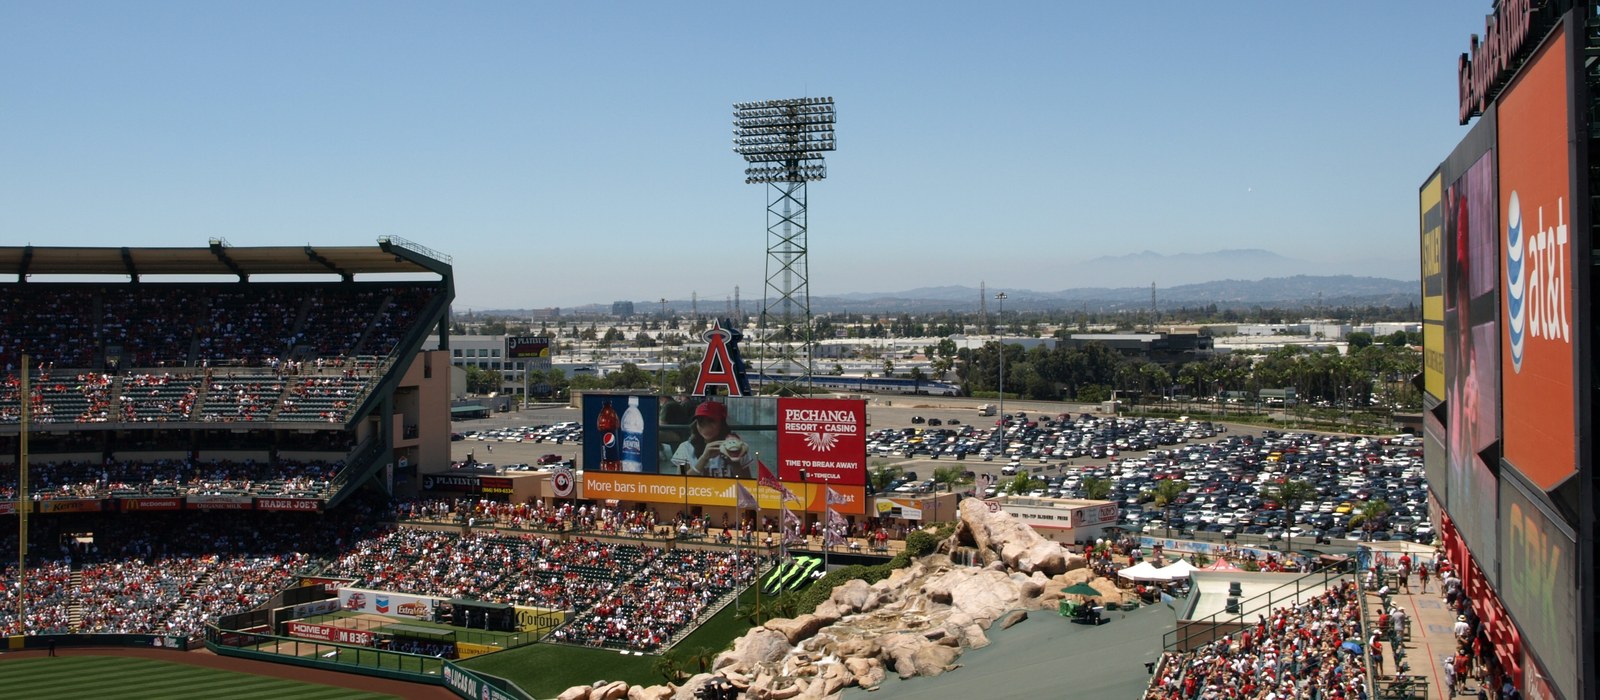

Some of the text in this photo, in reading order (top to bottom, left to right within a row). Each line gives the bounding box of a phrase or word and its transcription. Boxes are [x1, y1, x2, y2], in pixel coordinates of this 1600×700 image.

[1528, 197, 1569, 343] at&t
[692, 318, 742, 396] A
[785, 409, 856, 422] PECHANGA
[785, 423, 856, 432] RESORT CASINO
[436, 477, 481, 487] PLATINUM
[587, 480, 612, 491] More
[614, 481, 636, 493] bars
[638, 482, 647, 494] in
[650, 485, 676, 495] more
[260, 500, 318, 509] TRADER JOE'S
[293, 624, 330, 635] HOME of
[451, 668, 469, 692] LUCAS
[467, 678, 477, 698] OIL
